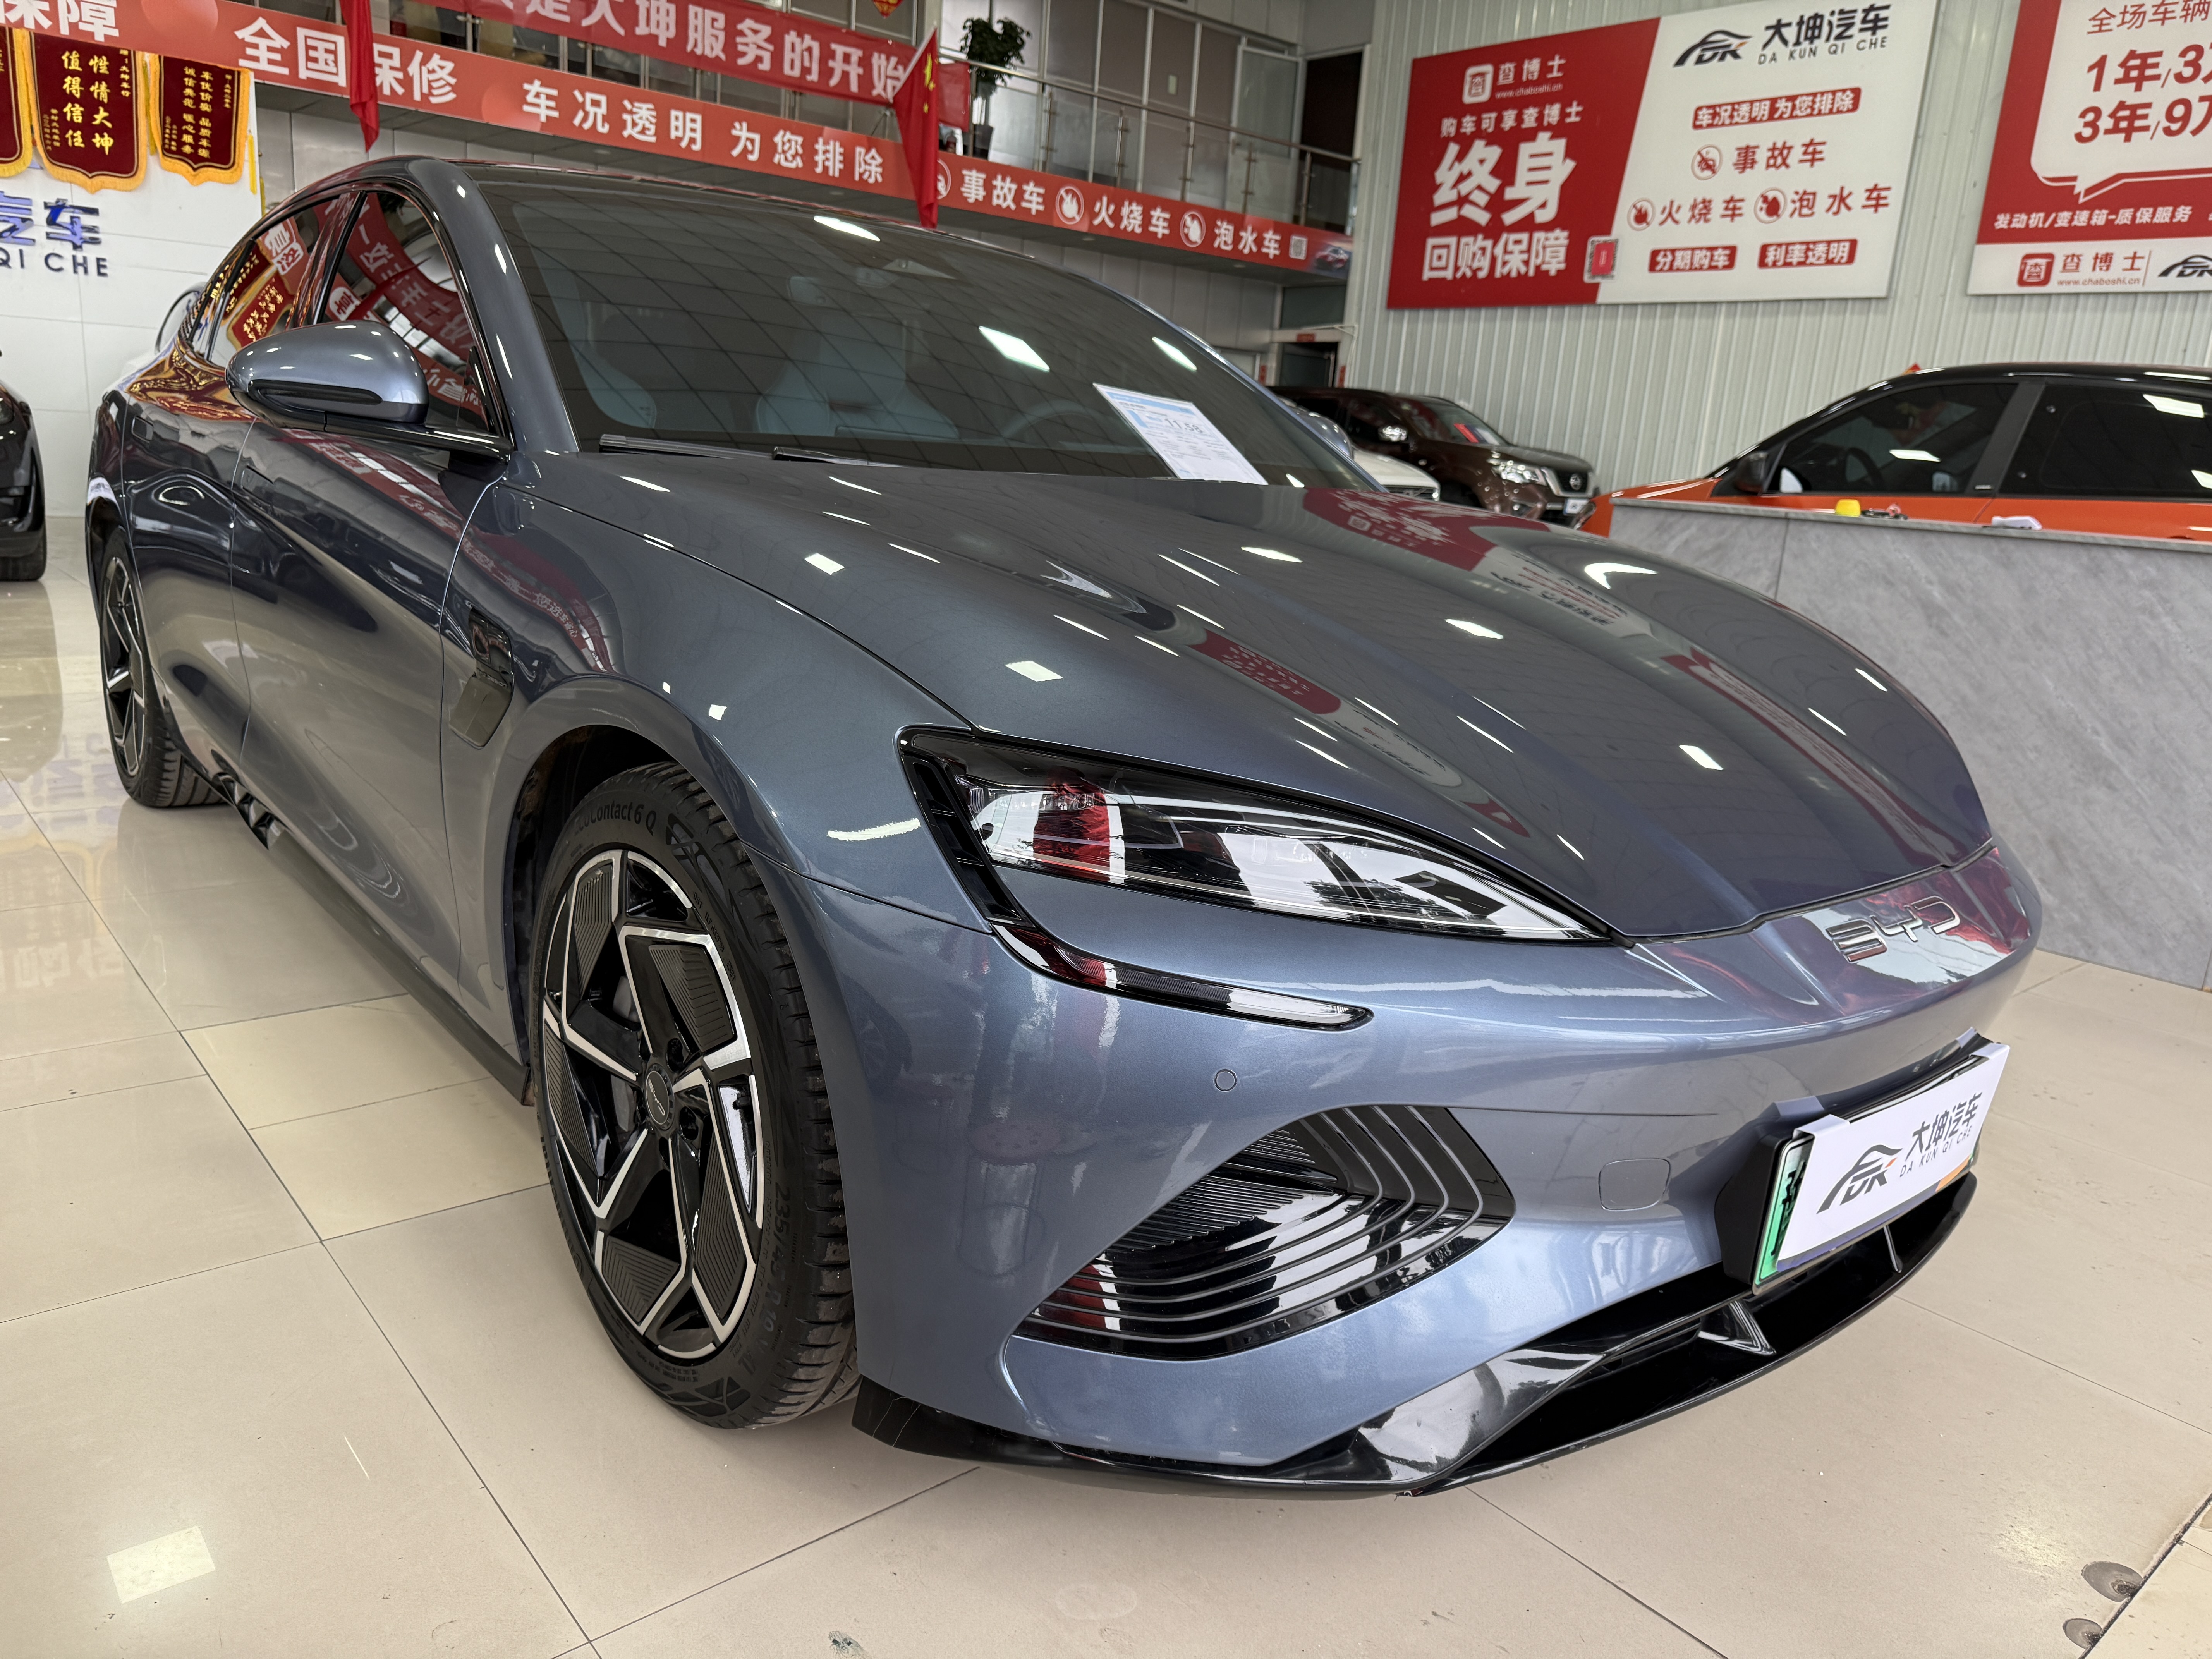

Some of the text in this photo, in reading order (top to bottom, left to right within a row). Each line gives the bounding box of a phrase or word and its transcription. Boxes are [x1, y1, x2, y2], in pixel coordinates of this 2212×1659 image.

[1760, 3, 1892, 51] 大坤汽车
[2086, 0, 2210, 35] 全场车辆
[1496, 54, 1566, 86] 查博士
[1757, 36, 1888, 65] DA KUN QI CHE
[2086, 41, 2212, 93] 1年/3
[61, 50, 85, 148] 值得信任
[88, 55, 114, 156] 性情大坤
[1440, 100, 1584, 139] 购车可享查博士
[1693, 90, 1855, 128] 车况透明 为您排除
[234, 17, 457, 104] 全国保修
[522, 79, 702, 151] 车况透明
[730, 121, 883, 184] 为您排除
[960, 169, 1046, 215] 事故车
[1092, 195, 1171, 238] 火烧车
[1213, 219, 1281, 259] 泡水车
[1732, 137, 1827, 174] 事故车
[1430, 131, 1577, 227] 终身
[1658, 183, 1892, 227] 火烧车 泡水车
[1993, 205, 2193, 230] 发动机/变速箱-质保服务
[44, 252, 108, 277] CHE
[1422, 227, 1570, 281] 回购保障
[1655, 241, 1851, 271] 分期购车 利率透明
[2060, 251, 2146, 273] 查博士
[1826, 895, 1961, 964] BYD
[648, 1079, 666, 1116] BYD
[1904, 1092, 1983, 1162] 大坤汽车
[1899, 1125, 1973, 1177] DA KUN QI CHE
